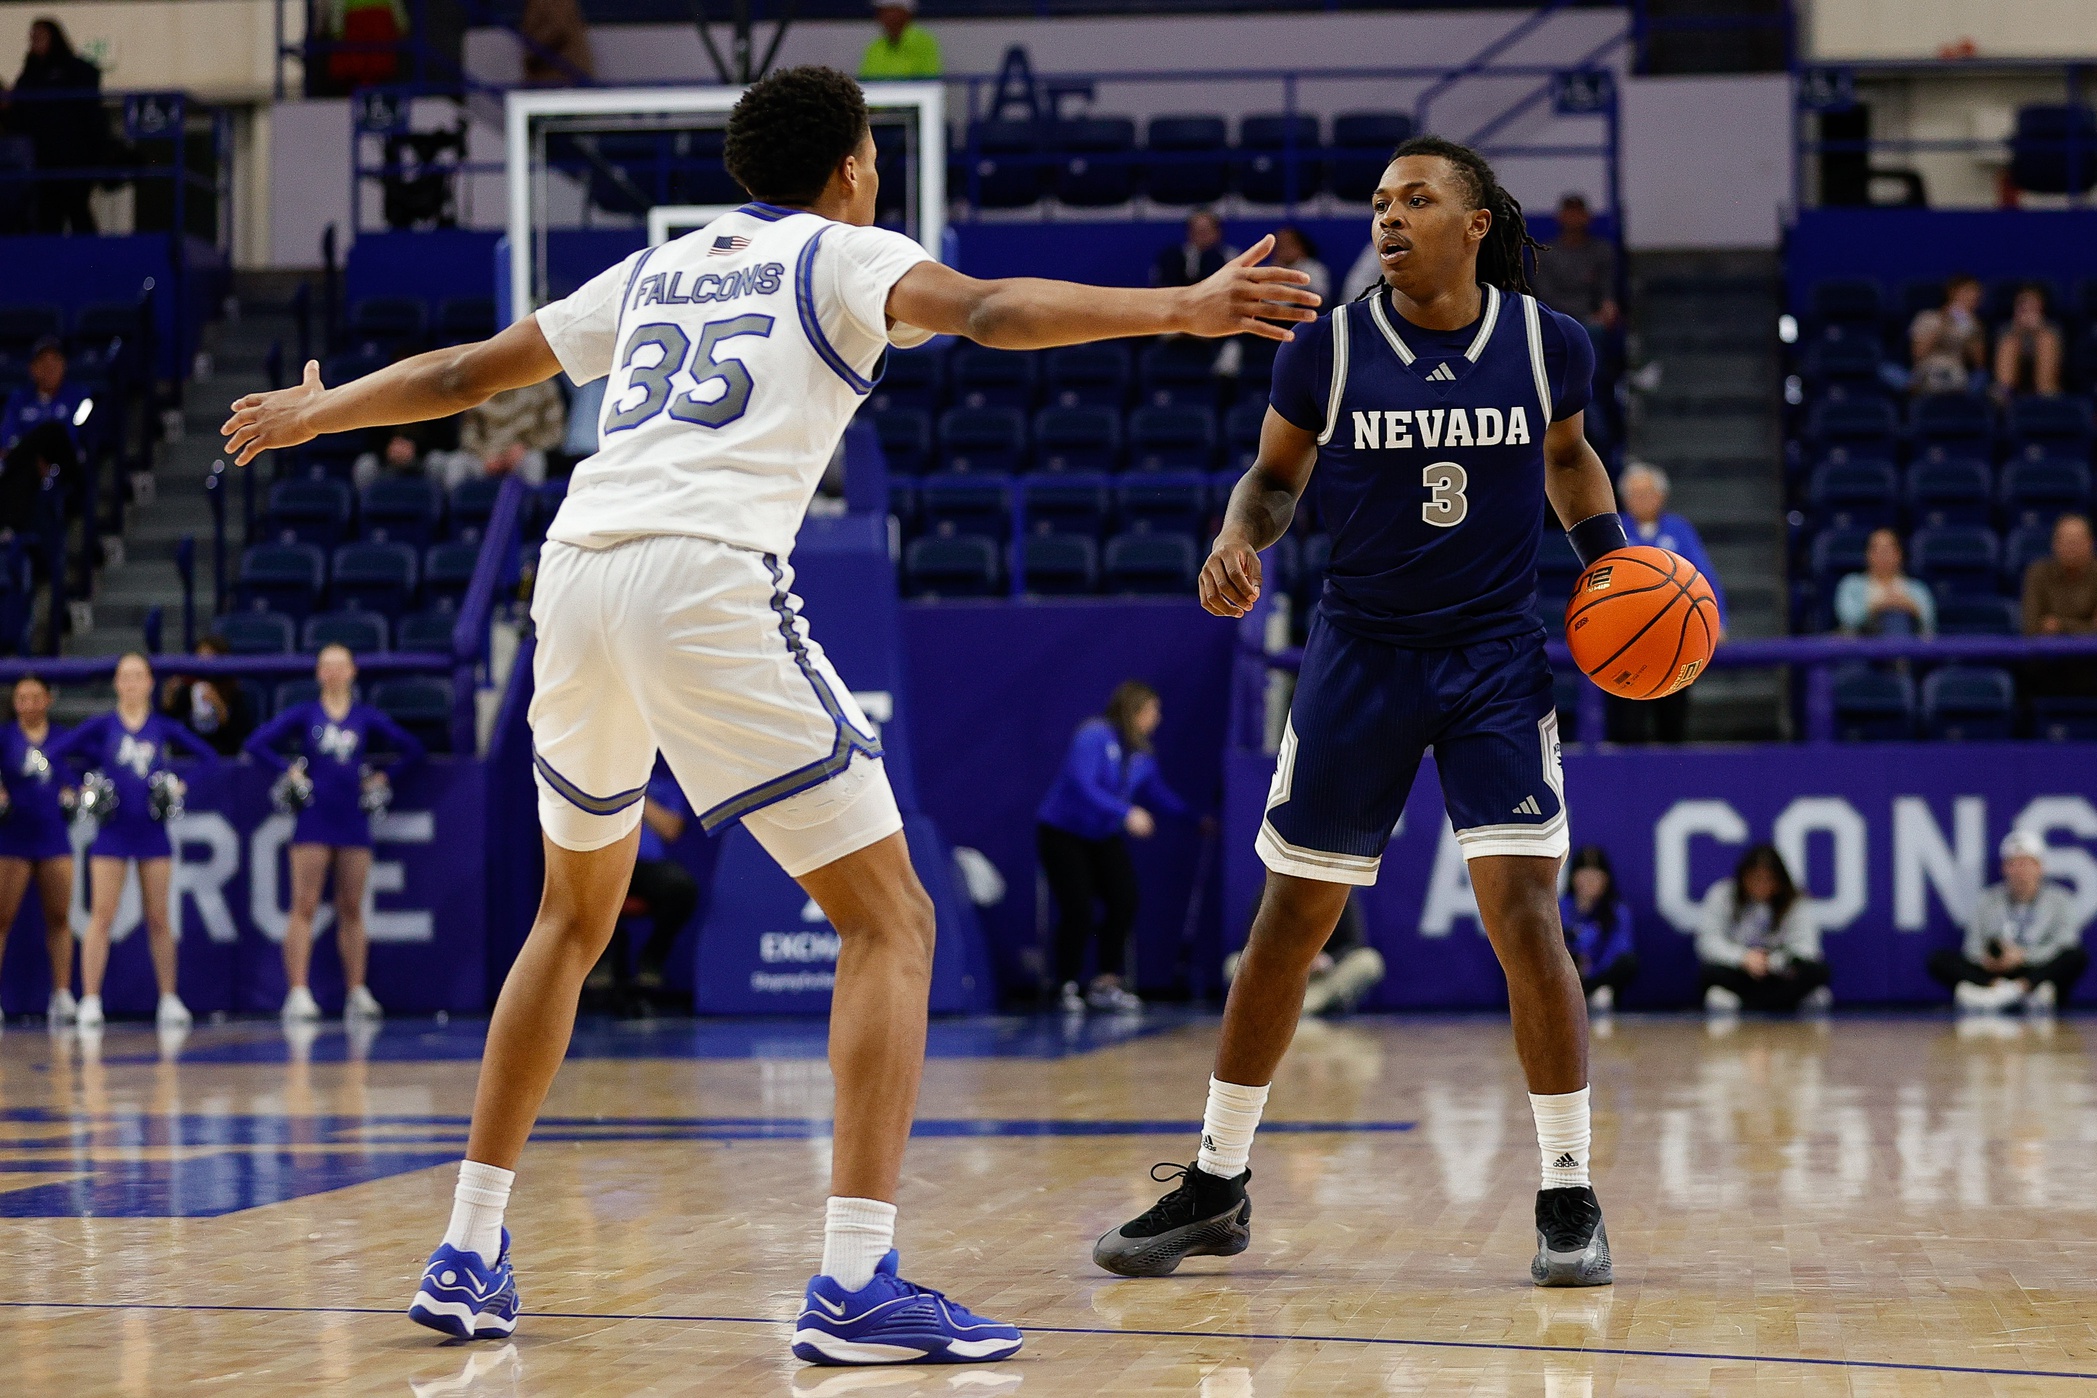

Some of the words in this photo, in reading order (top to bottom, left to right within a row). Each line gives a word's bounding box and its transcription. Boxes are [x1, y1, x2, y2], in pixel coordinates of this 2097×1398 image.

[632, 262, 785, 311] FALCONS
[604, 313, 775, 436] 35
[1352, 406, 1531, 450] NEVADA
[1422, 461, 1468, 528] 3
[1552, 1160, 1579, 1168] adidas
